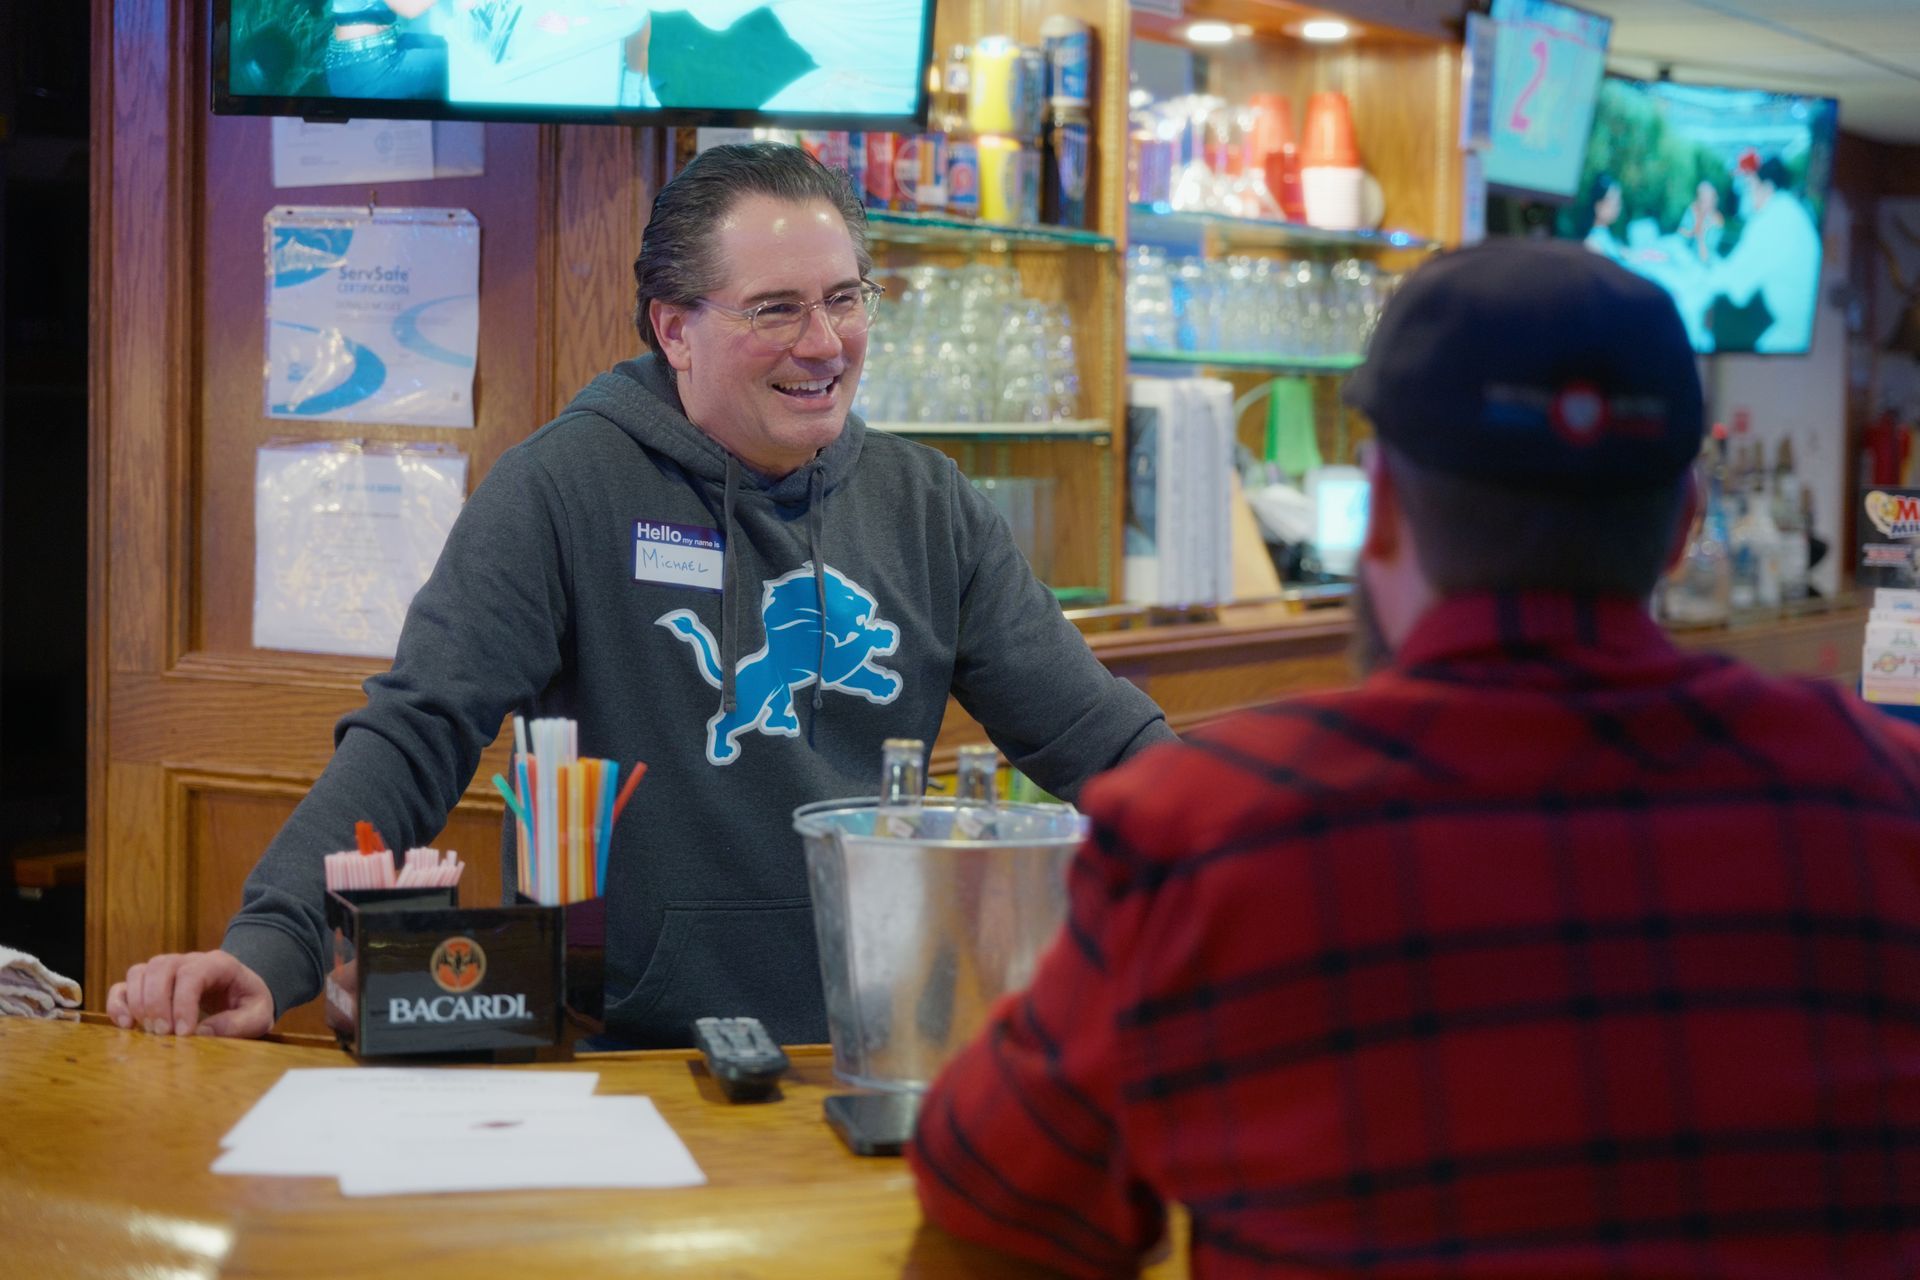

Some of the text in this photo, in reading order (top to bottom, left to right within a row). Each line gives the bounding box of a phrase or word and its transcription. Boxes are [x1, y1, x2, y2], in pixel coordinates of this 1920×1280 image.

[339, 265, 408, 282] ServSafe
[637, 522, 682, 543] Hello
[682, 538, 694, 546] my
[694, 539, 713, 547] name
[388, 993, 527, 1024] BACARDI
